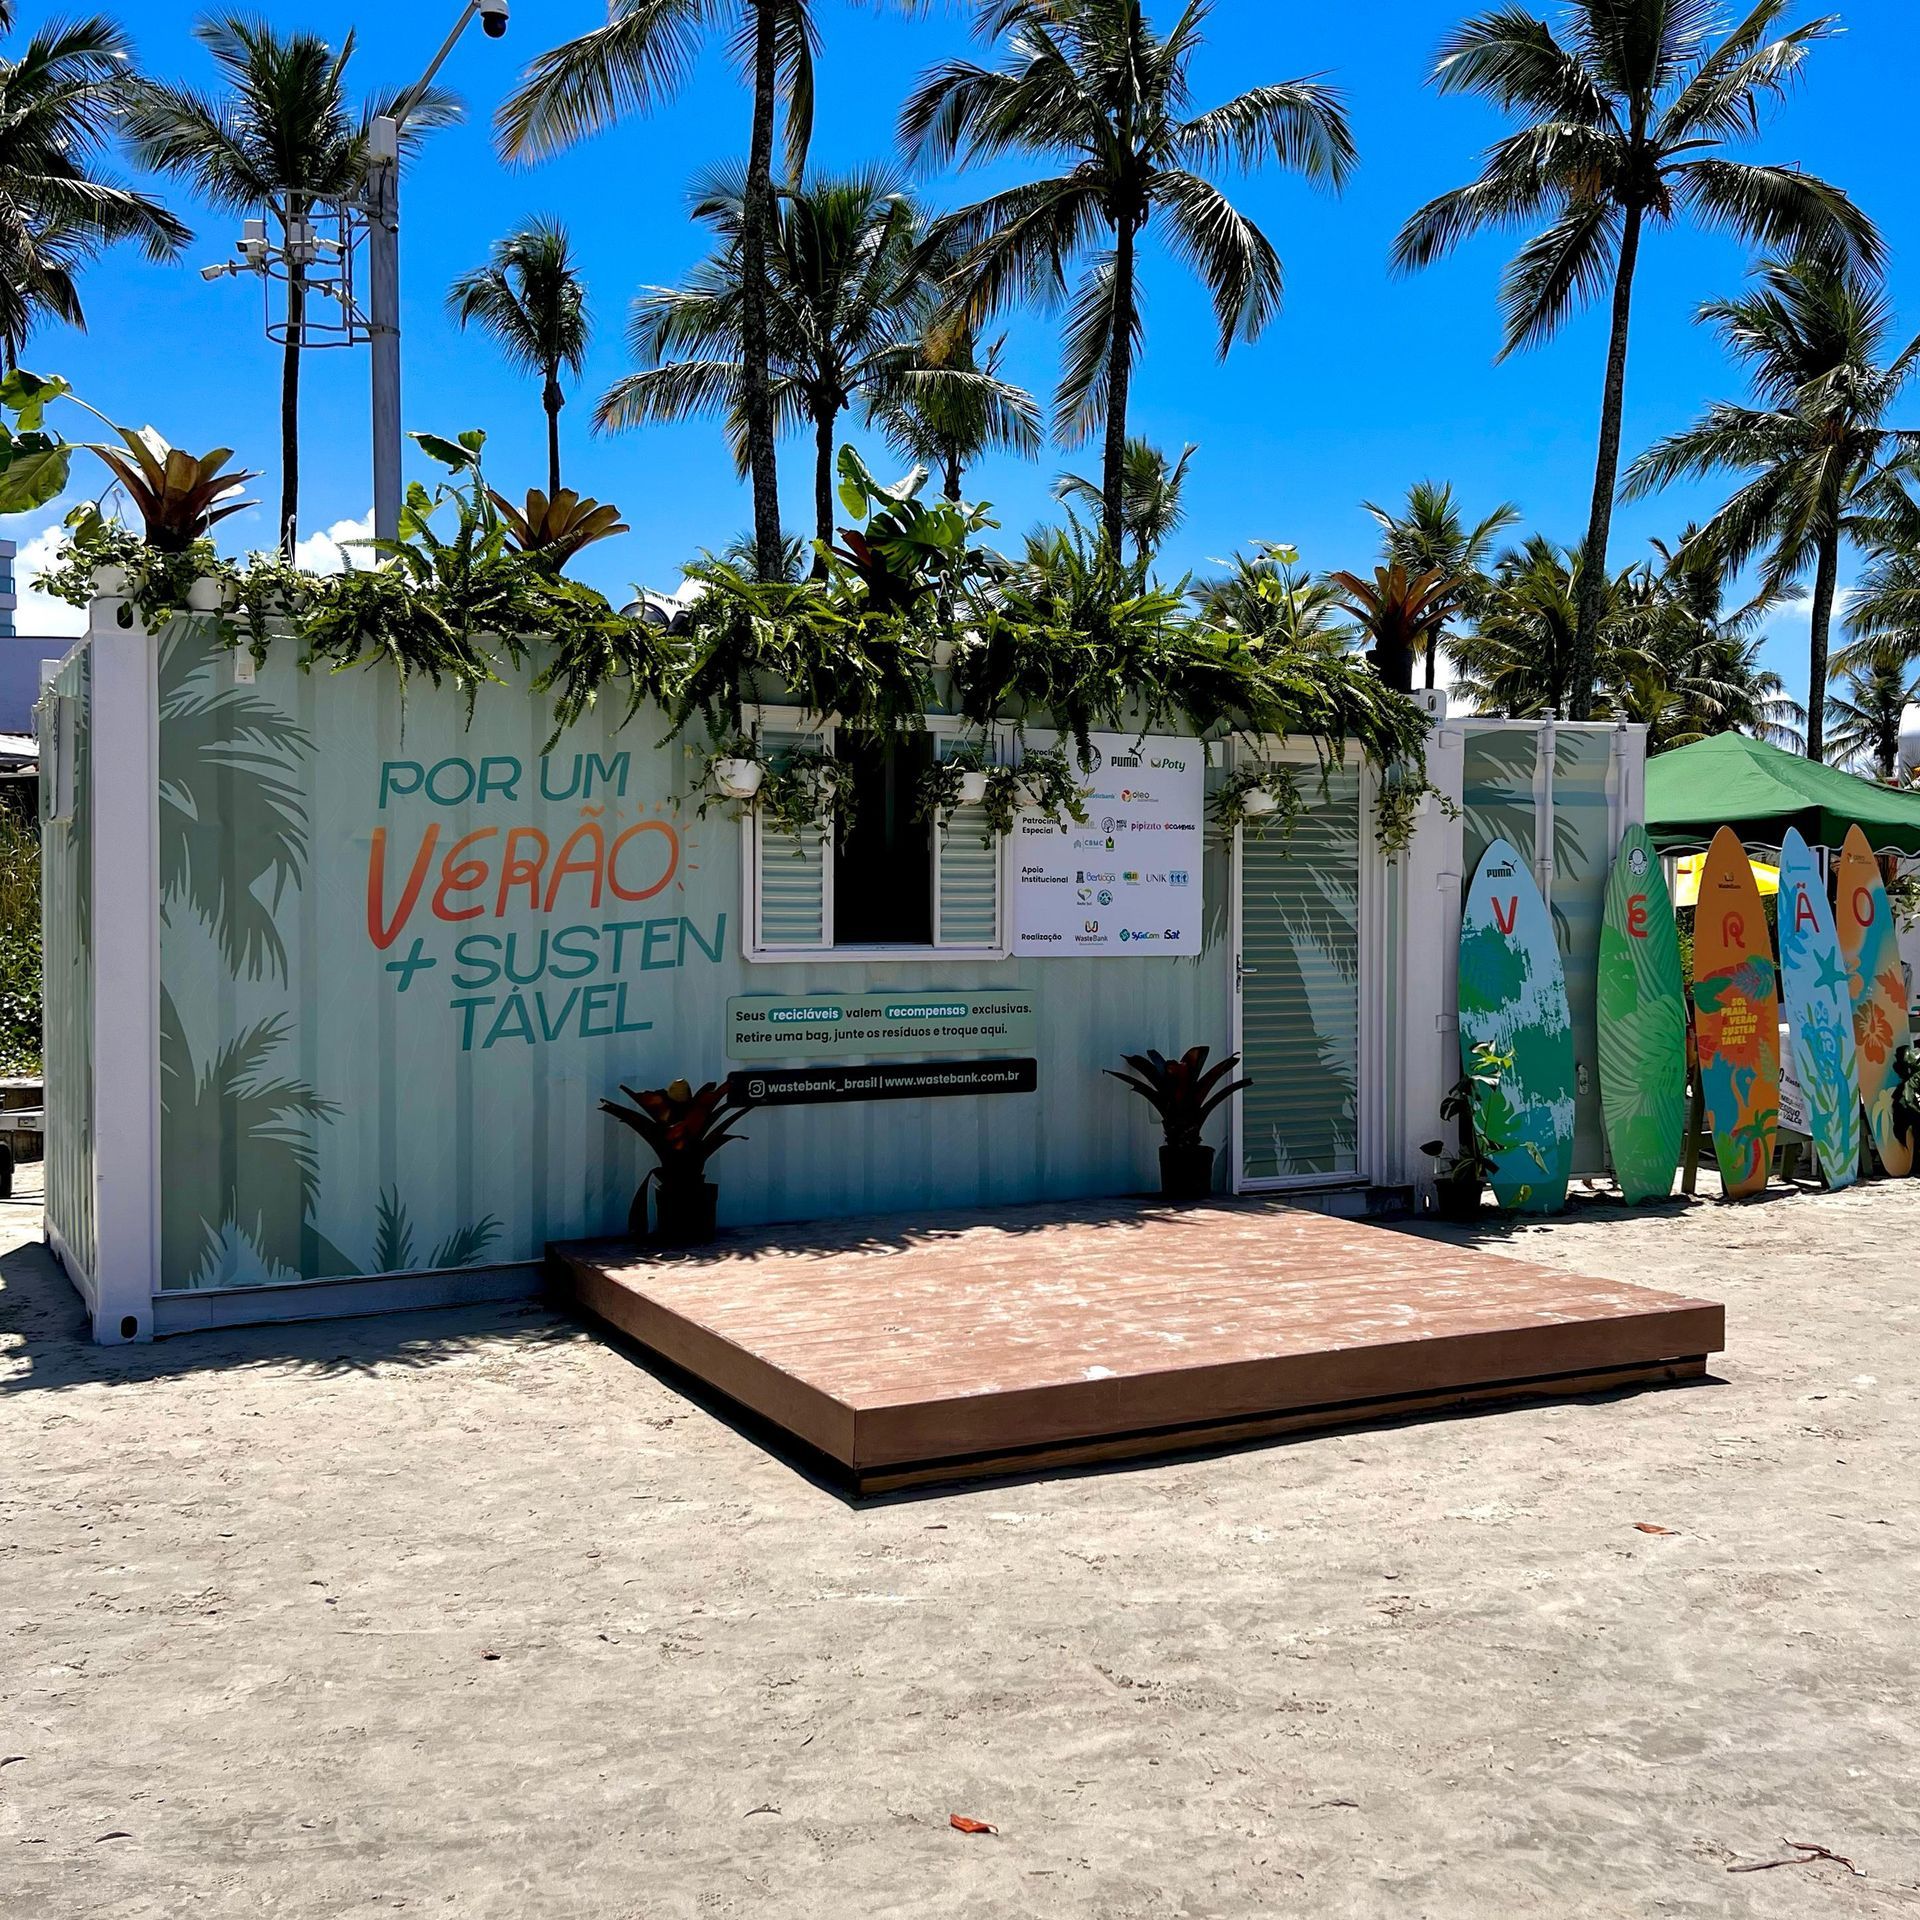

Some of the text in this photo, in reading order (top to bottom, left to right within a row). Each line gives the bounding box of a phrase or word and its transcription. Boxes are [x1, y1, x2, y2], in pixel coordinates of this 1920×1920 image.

[1111, 756, 1138, 768] PUMA
[1162, 758, 1186, 772] Poty
[379, 751, 631, 809] POR UM
[1022, 827, 1054, 836] Especial
[367, 806, 680, 950] VERÃO
[1022, 866, 1044, 875] Apoio
[1486, 868, 1512, 878] PUMA
[1491, 896, 1518, 935] V
[1626, 894, 1648, 938] E
[1853, 887, 1875, 928] O
[1021, 933, 1062, 943] Realização
[1722, 911, 1745, 949] R
[451, 912, 727, 989] SUSTEN
[1731, 997, 1747, 1006] SOL
[450, 982, 653, 1051] TÁVEL
[735, 1003, 1032, 1021] Seus recicláveis valem recompensas exclusivas.
[1720, 1006, 1747, 1017] PRAIA
[1729, 1013, 1758, 1025] VERÃO
[736, 1023, 1008, 1044] Retire uma bag, junte os resíduos e troque aqui.
[1721, 1025, 1757, 1036] SUSTEN
[768, 1075, 877, 1094] wastebank_brasil
[885, 1071, 1020, 1088] www.wastebank.com.br
